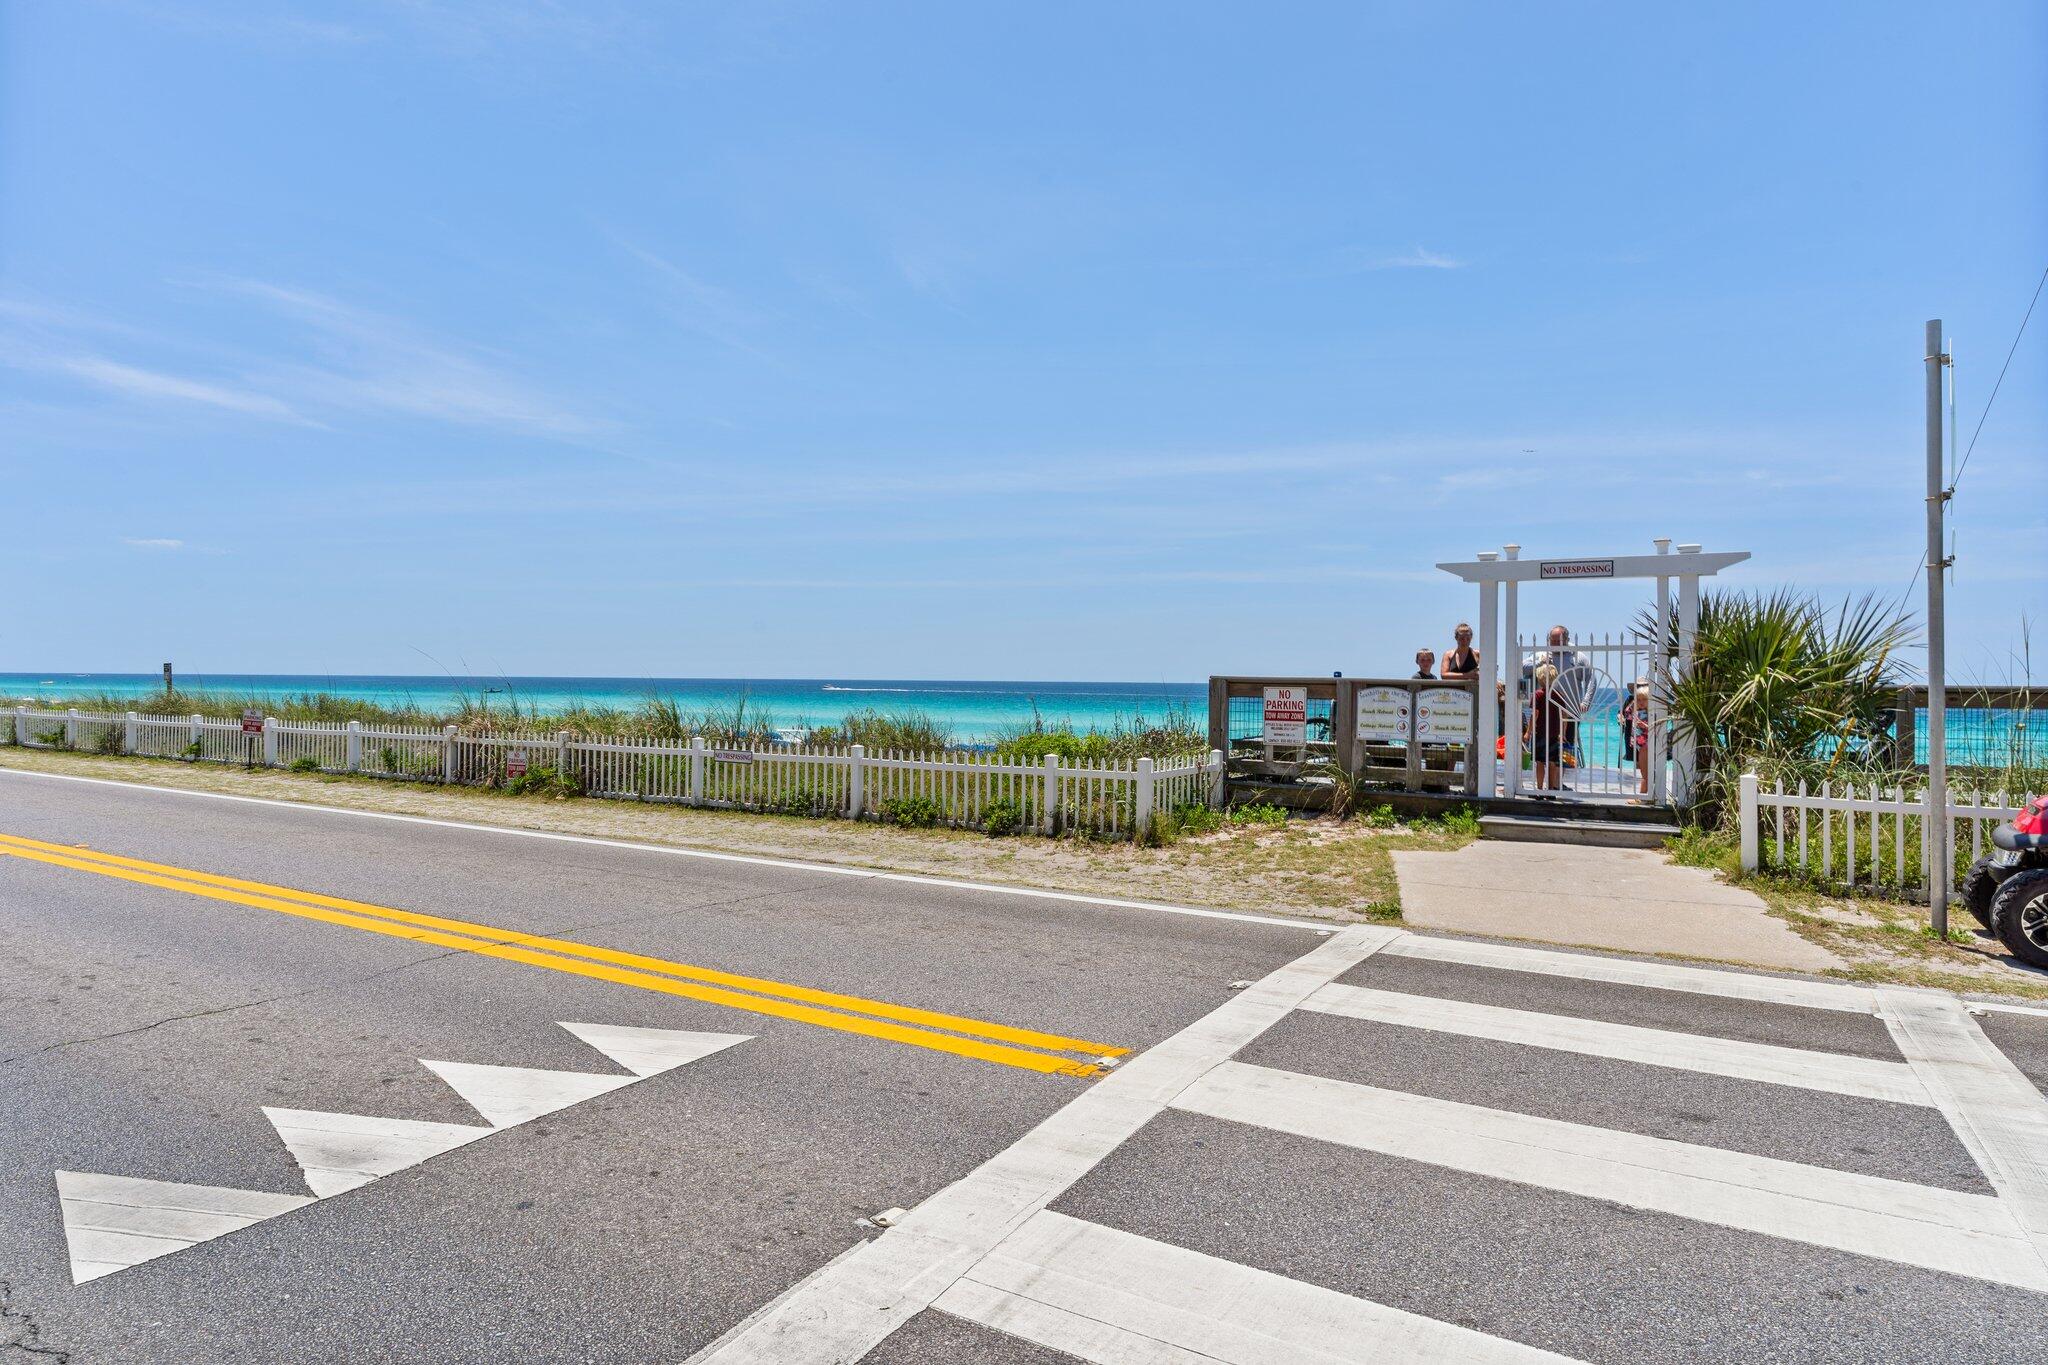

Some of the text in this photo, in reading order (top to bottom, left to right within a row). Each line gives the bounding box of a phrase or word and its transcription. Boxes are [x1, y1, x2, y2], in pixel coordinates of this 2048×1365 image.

[1559, 565, 1611, 574] TRESPASSING
[1279, 690, 1291, 699] NO
[1266, 700, 1304, 710] PARKING
[723, 752, 751, 760] TRESPASSING
